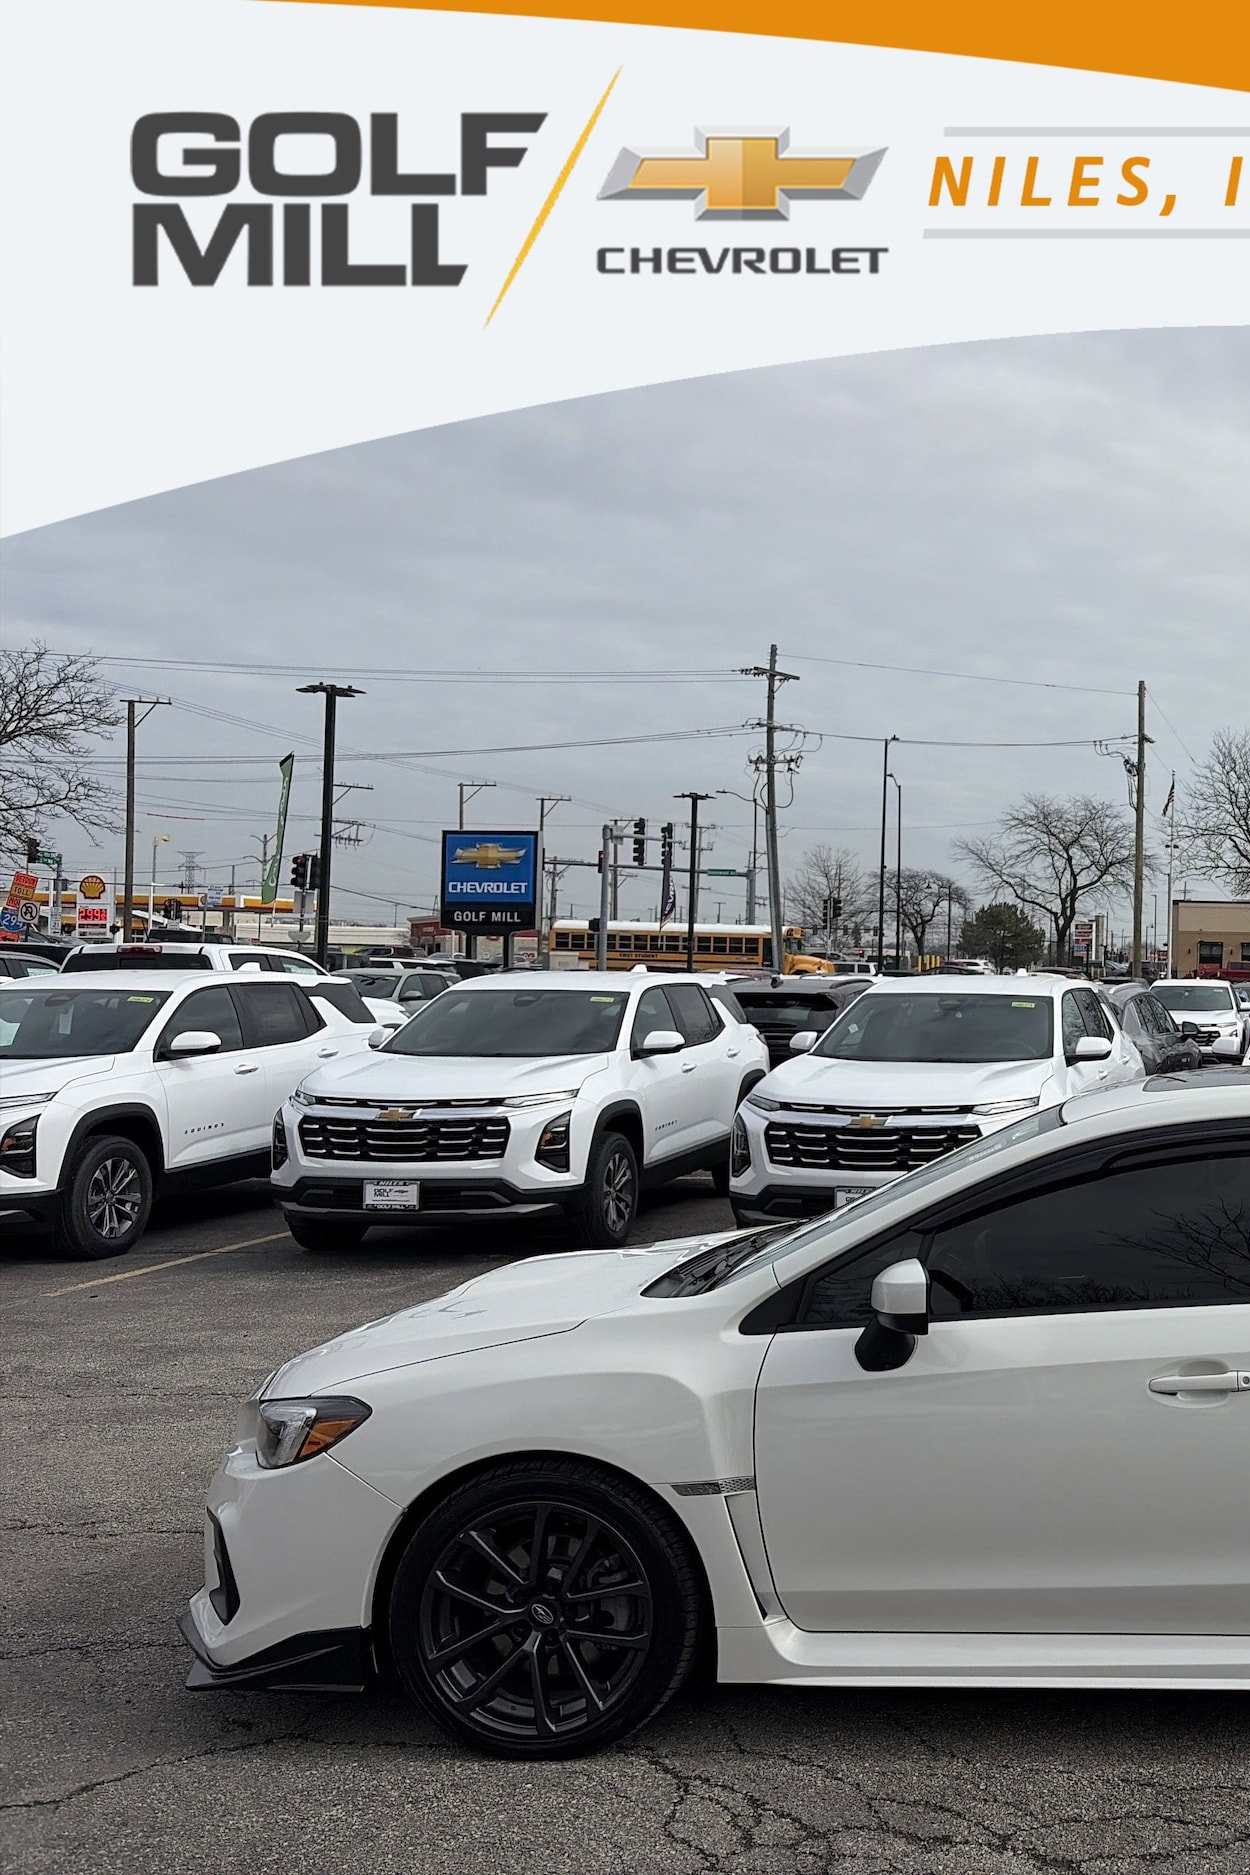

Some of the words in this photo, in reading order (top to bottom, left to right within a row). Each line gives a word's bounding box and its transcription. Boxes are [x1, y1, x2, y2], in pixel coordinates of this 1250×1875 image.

[448, 882, 528, 894] CHEVROLET
[454, 911, 486, 922] GOLF
[491, 911, 521, 922] MILL
